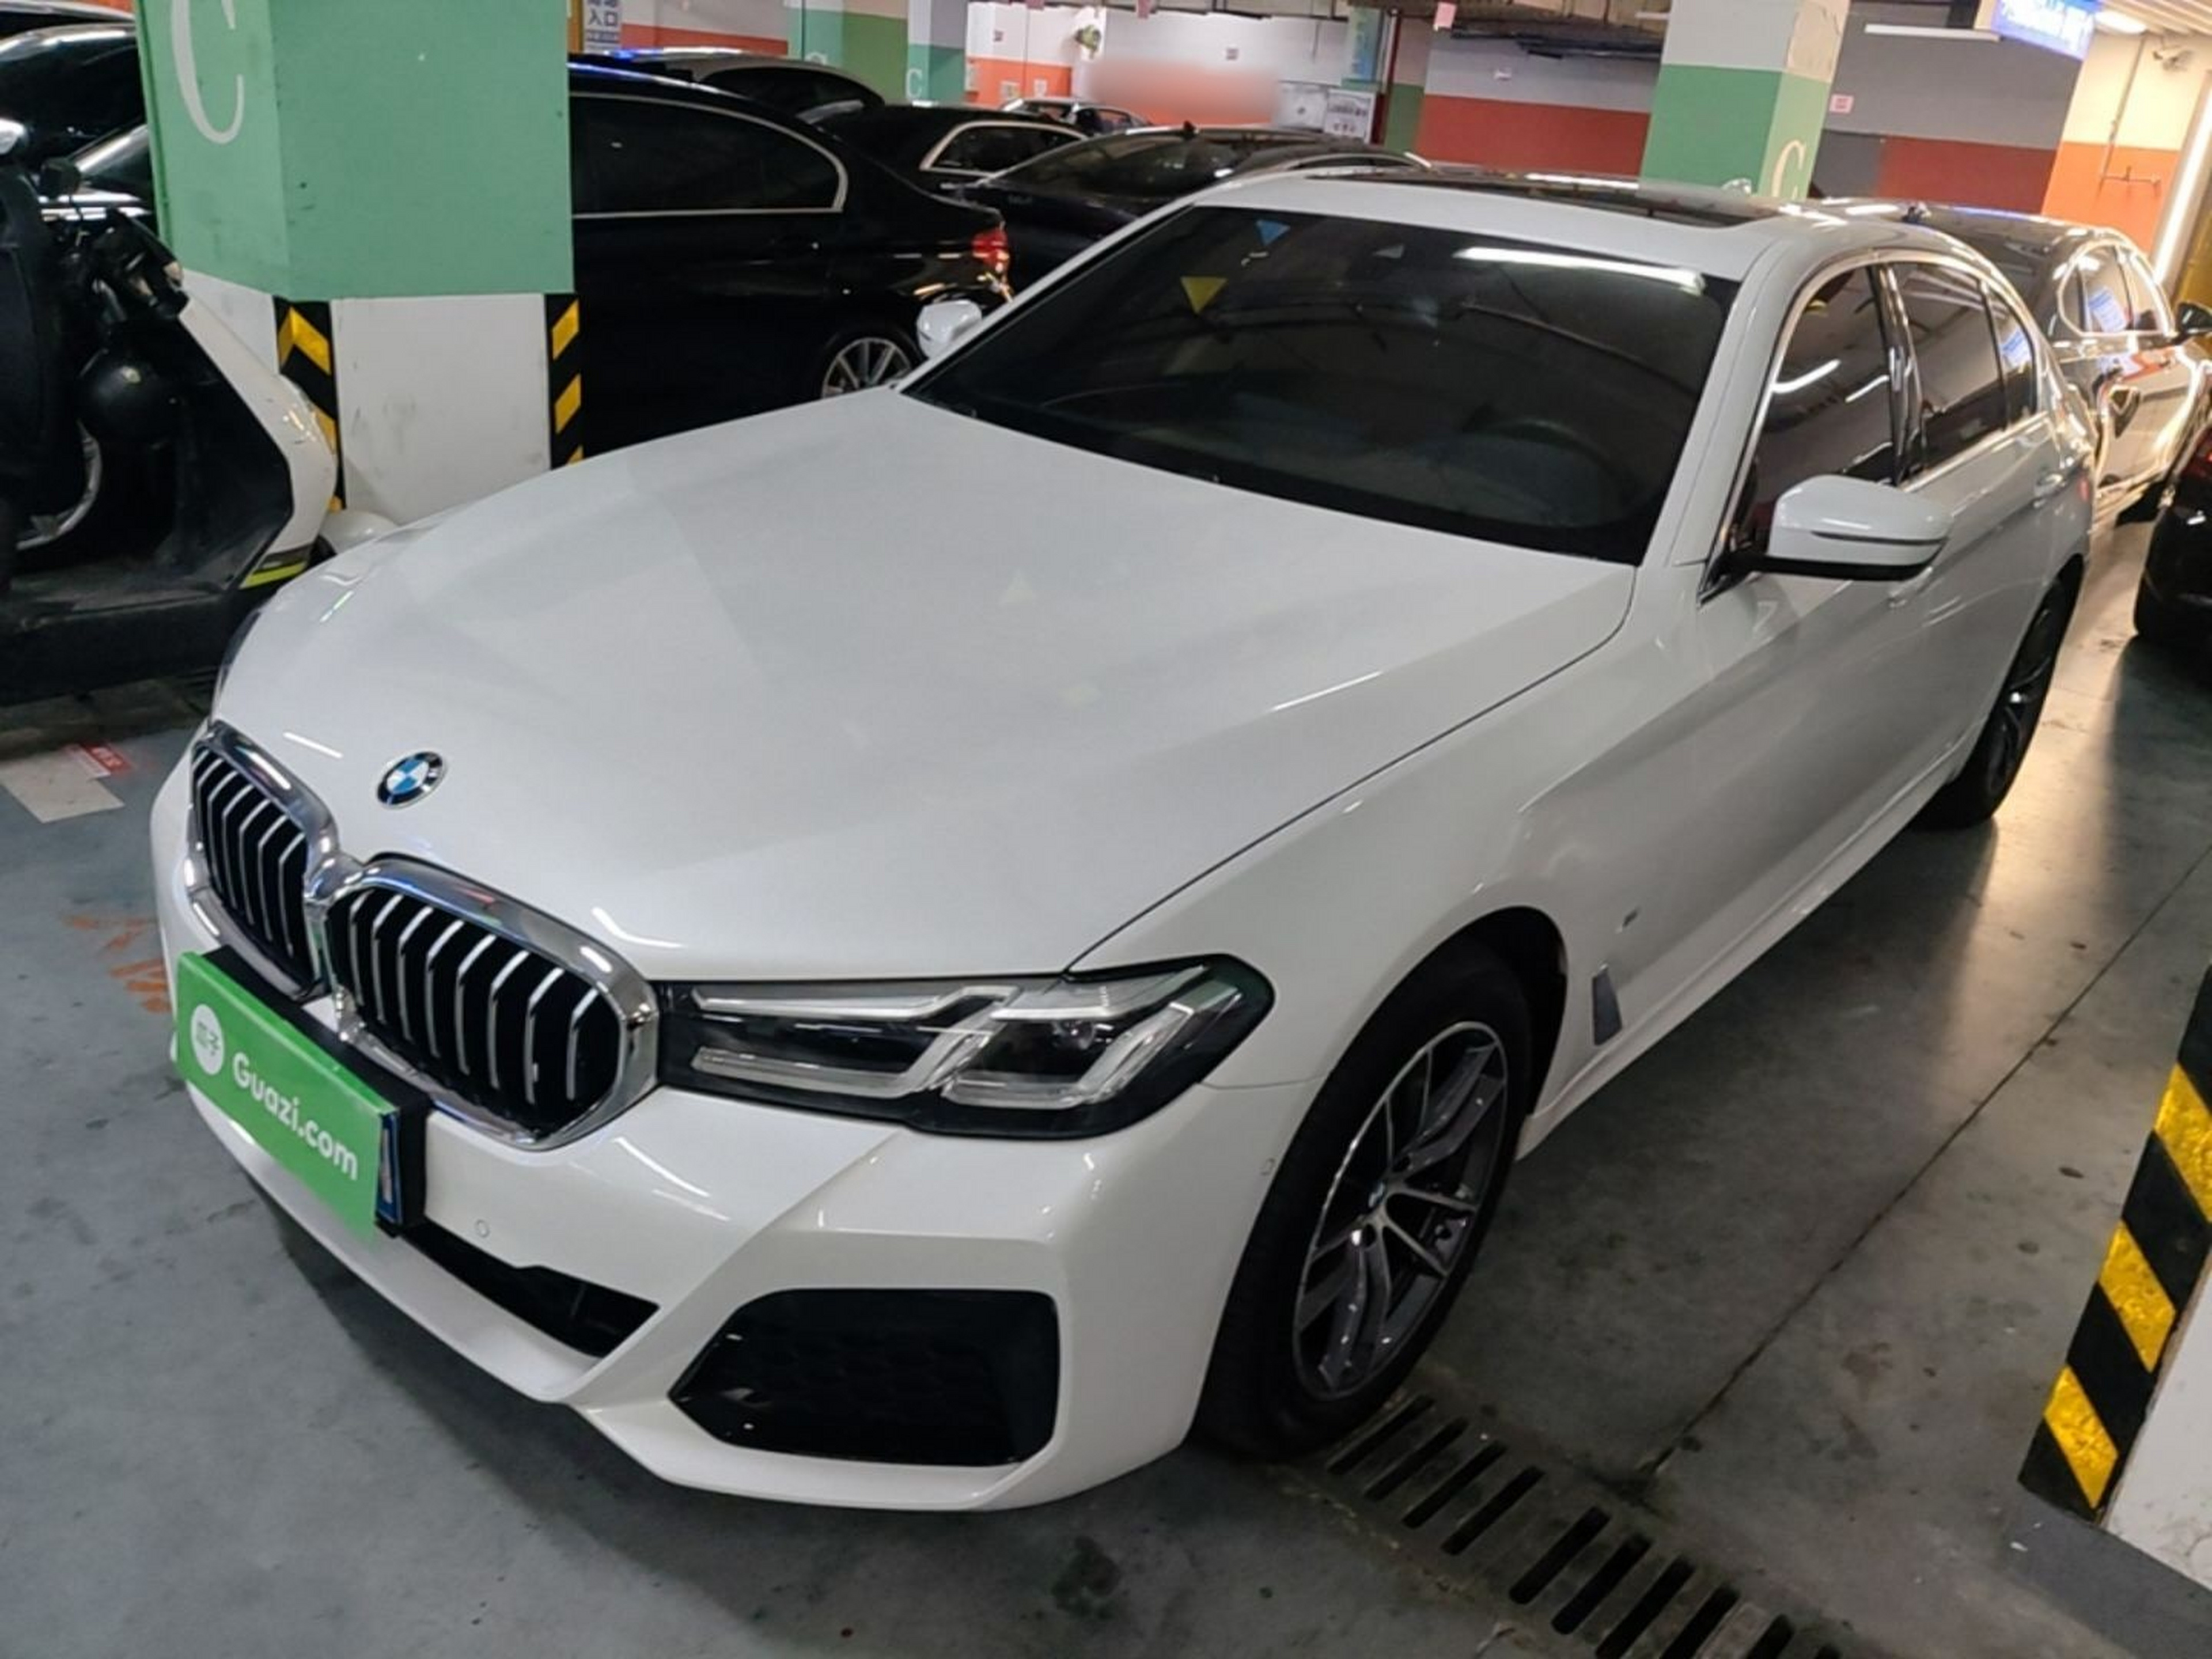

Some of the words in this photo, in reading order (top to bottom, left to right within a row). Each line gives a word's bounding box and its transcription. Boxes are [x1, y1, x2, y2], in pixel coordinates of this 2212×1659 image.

[588, 8, 619, 27] 入口
[906, 67, 925, 100] C
[232, 1052, 358, 1181] Guazi.com
